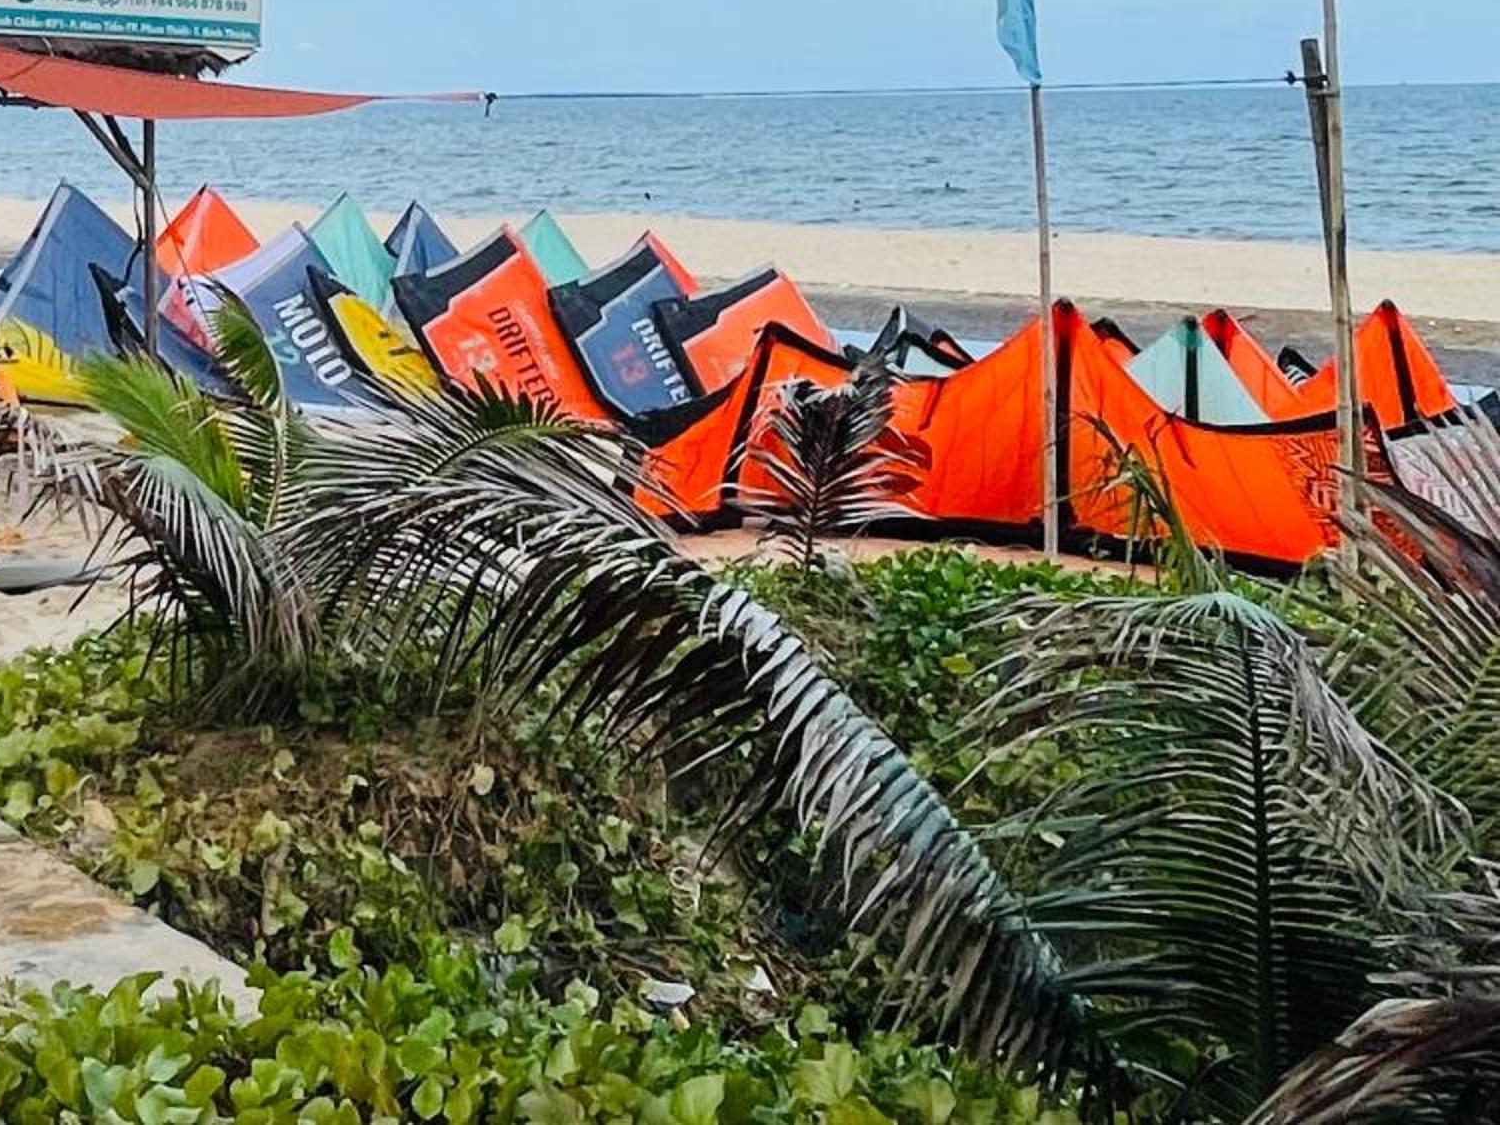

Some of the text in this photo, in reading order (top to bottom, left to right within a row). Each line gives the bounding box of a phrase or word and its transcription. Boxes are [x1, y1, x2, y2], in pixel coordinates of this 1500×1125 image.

[273, 291, 353, 386] MOTO
[487, 305, 555, 402] DRIFTER
[631, 317, 692, 407] DRIFTE
